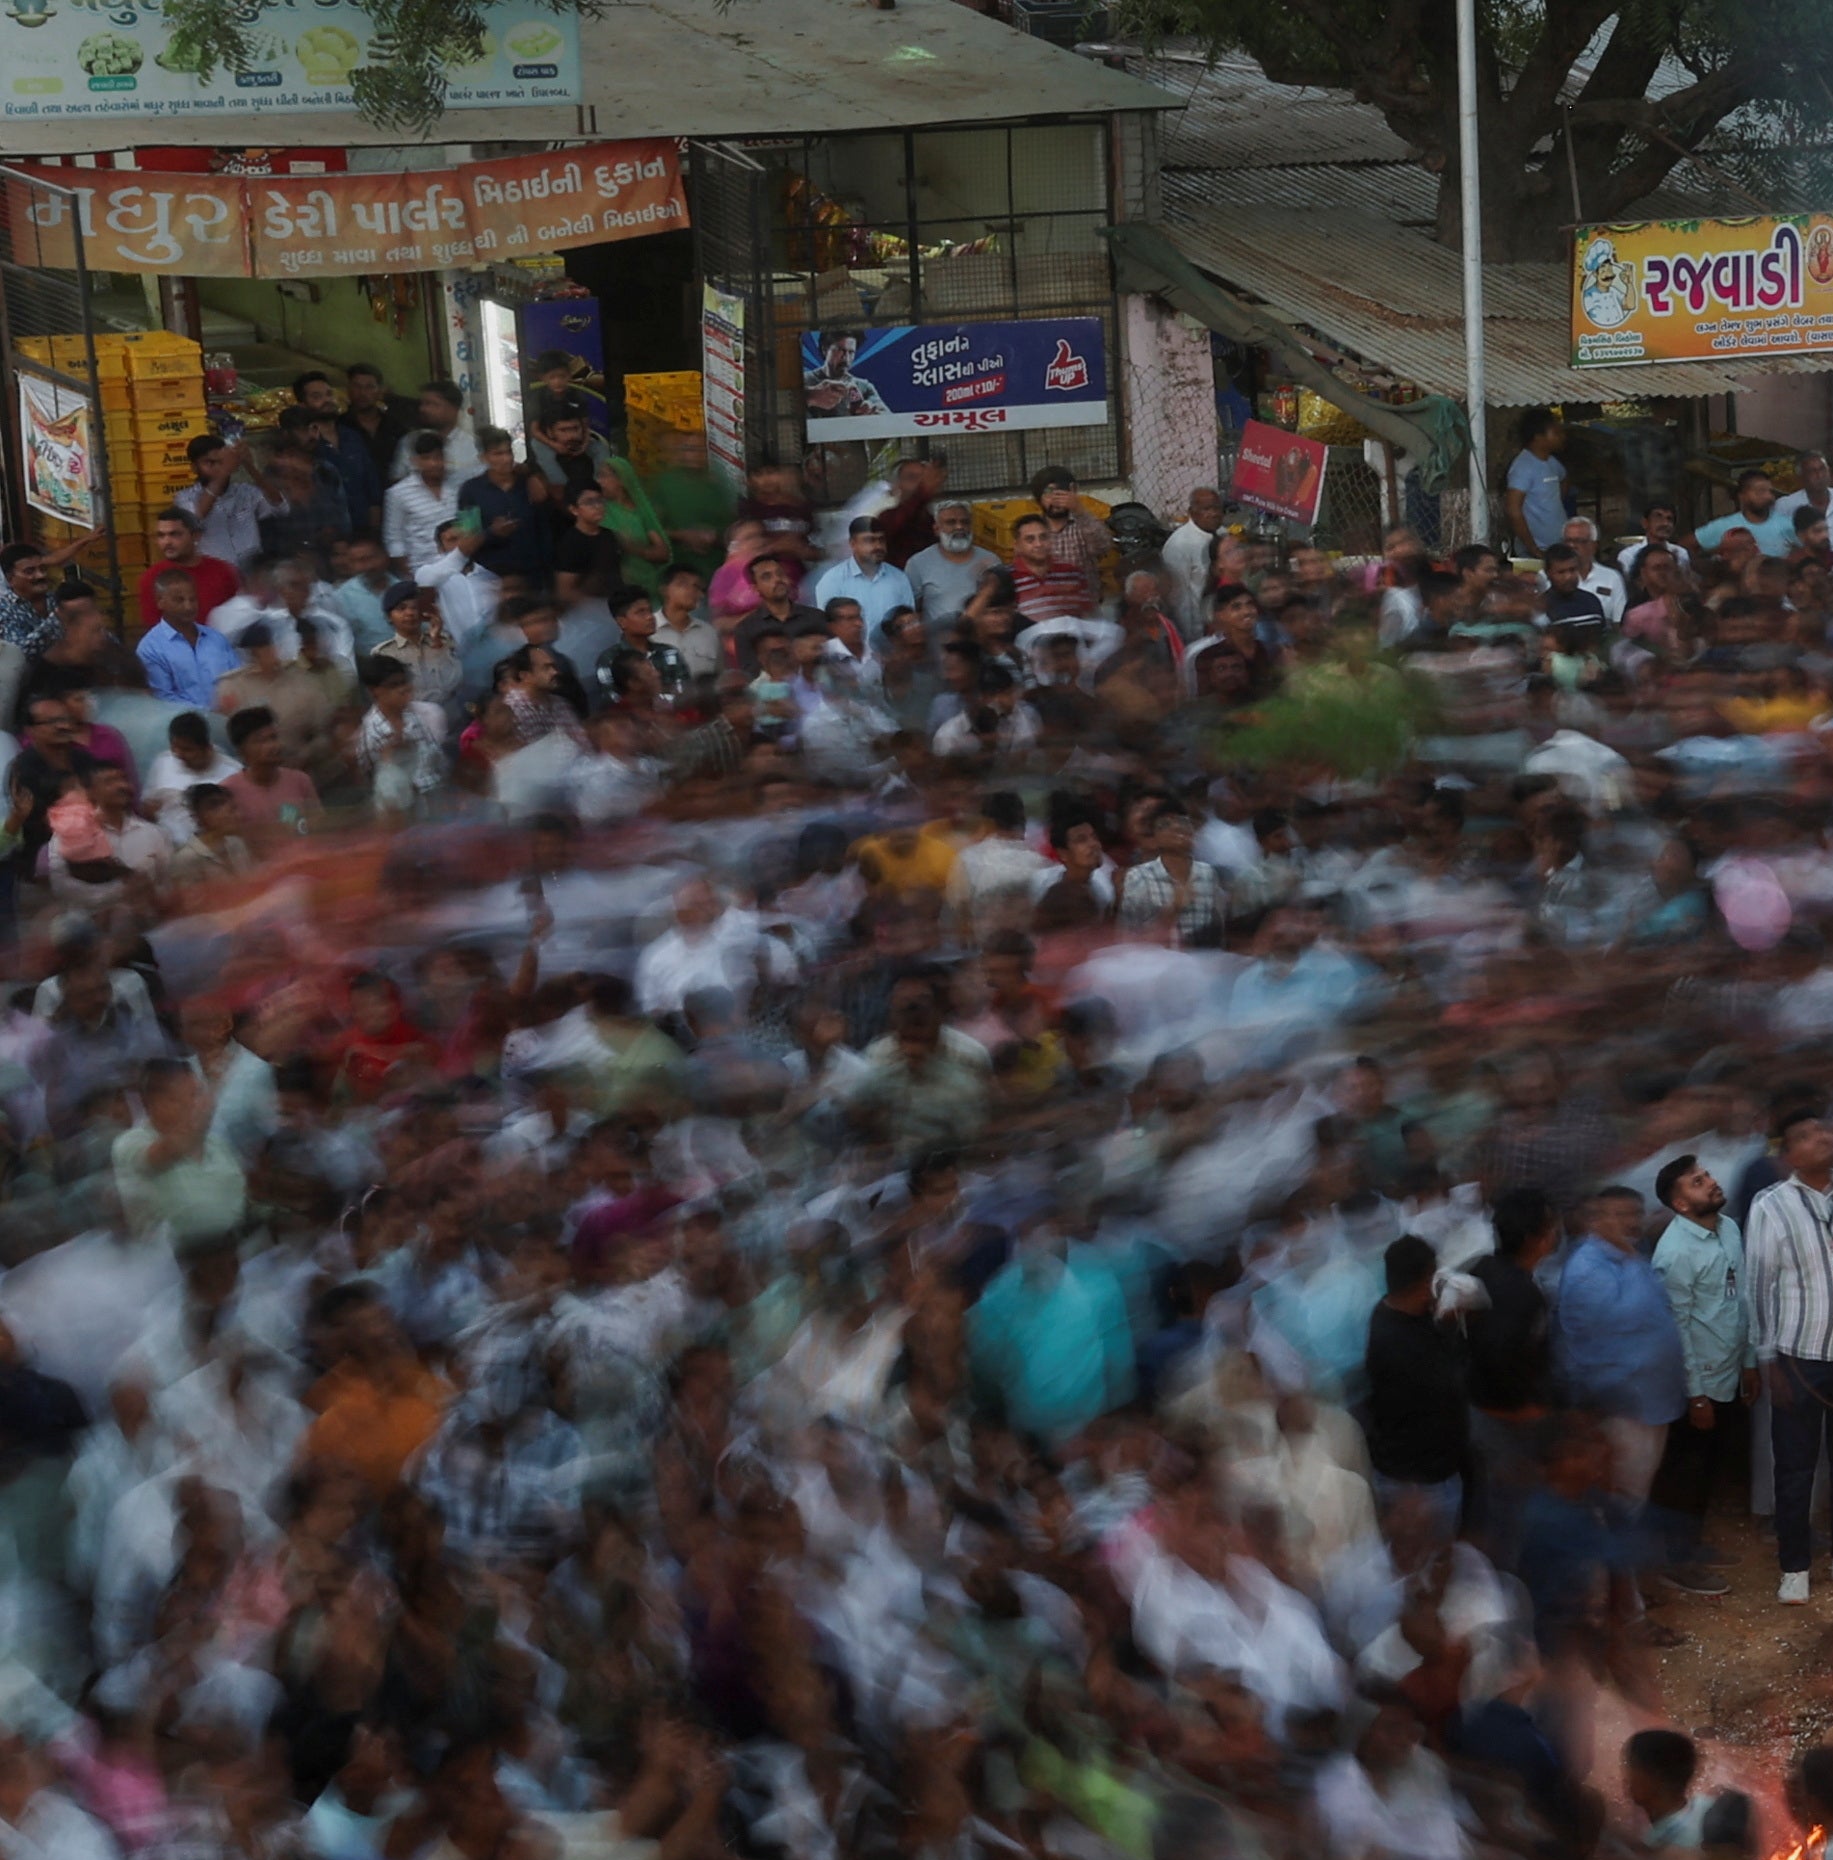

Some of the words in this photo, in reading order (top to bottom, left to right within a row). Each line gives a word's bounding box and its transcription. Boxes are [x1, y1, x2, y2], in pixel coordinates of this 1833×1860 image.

[473, 162, 583, 207] મિઠાઈની
[594, 156, 667, 198] દુકાન
[26, 186, 230, 265] મધુર
[263, 190, 338, 240] ડેરી
[351, 184, 466, 236] પાર્લર
[333, 249, 376, 265] માવા
[386, 246, 422, 263] તથા
[507, 224, 529, 246] ની
[537, 214, 595, 240] બનેલી
[603, 199, 682, 229] મિઠાઈઓ
[1644, 225, 1800, 314] રજવાડી
[946, 385, 974, 402] 200ml
[1050, 362, 1084, 381] Thums
[914, 408, 1007, 430] અમૂલ
